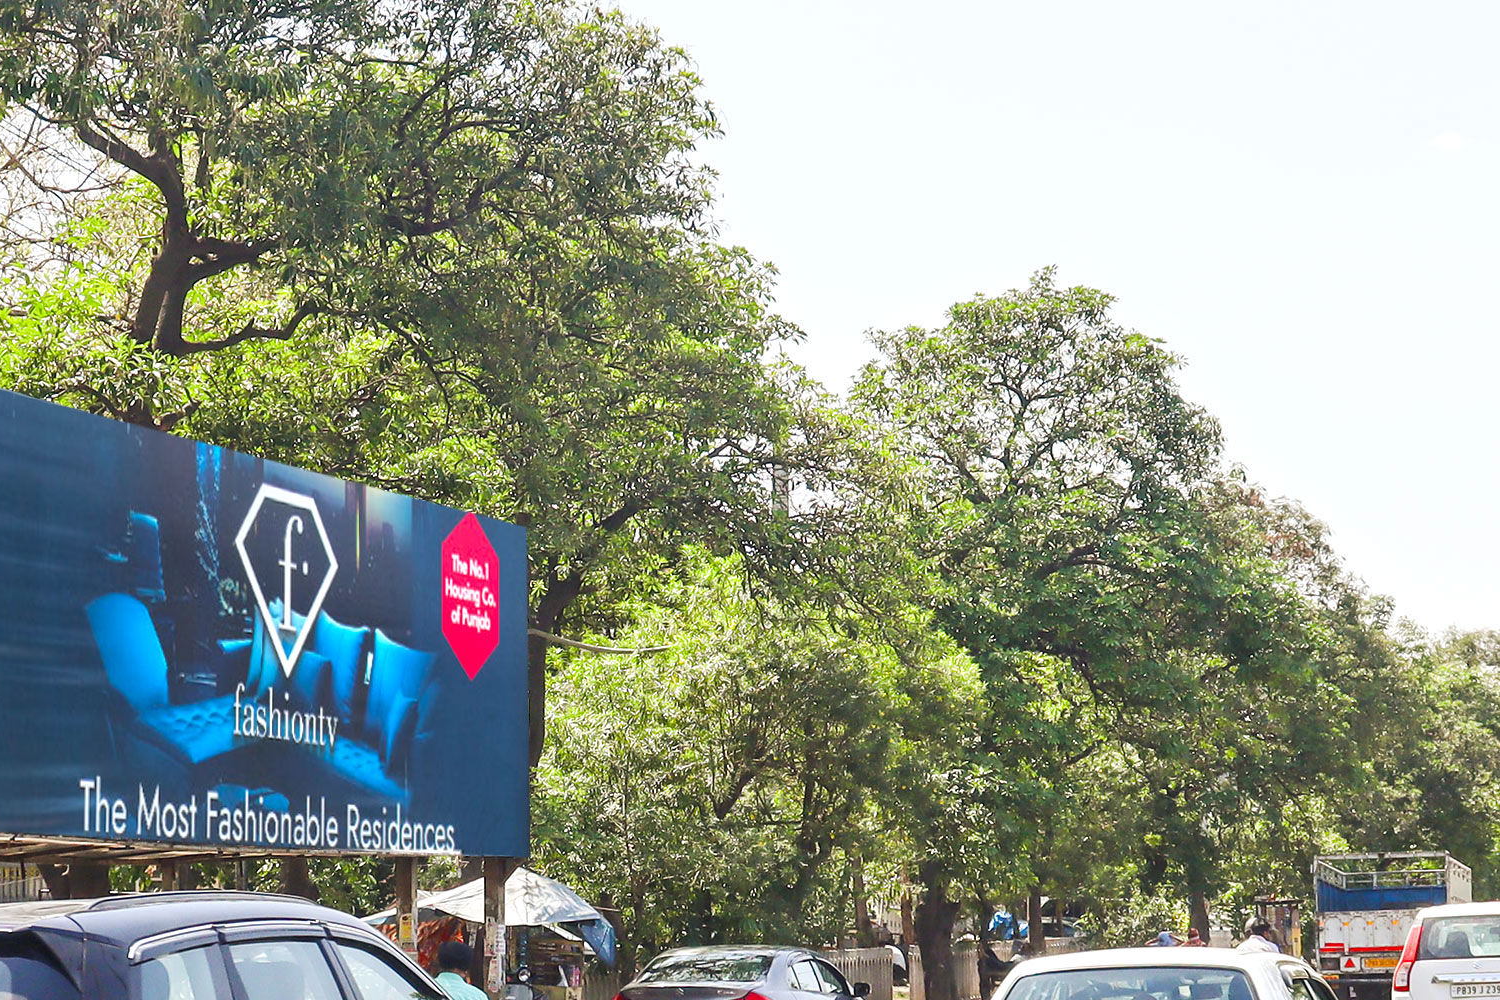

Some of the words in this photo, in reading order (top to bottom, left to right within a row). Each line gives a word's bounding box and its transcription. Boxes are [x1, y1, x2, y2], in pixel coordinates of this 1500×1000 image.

[451, 553, 468, 576] The
[469, 558, 490, 581] No.1
[444, 577, 480, 608] Housing
[481, 586, 497, 608] Co.
[450, 604, 461, 625] of
[461, 606, 492, 634] Punjab
[232, 682, 338, 748] fashiontv
[79, 776, 127, 836] The
[136, 783, 198, 841] Most
[205, 789, 339, 850] Fashionable
[346, 802, 456, 853] Residences
